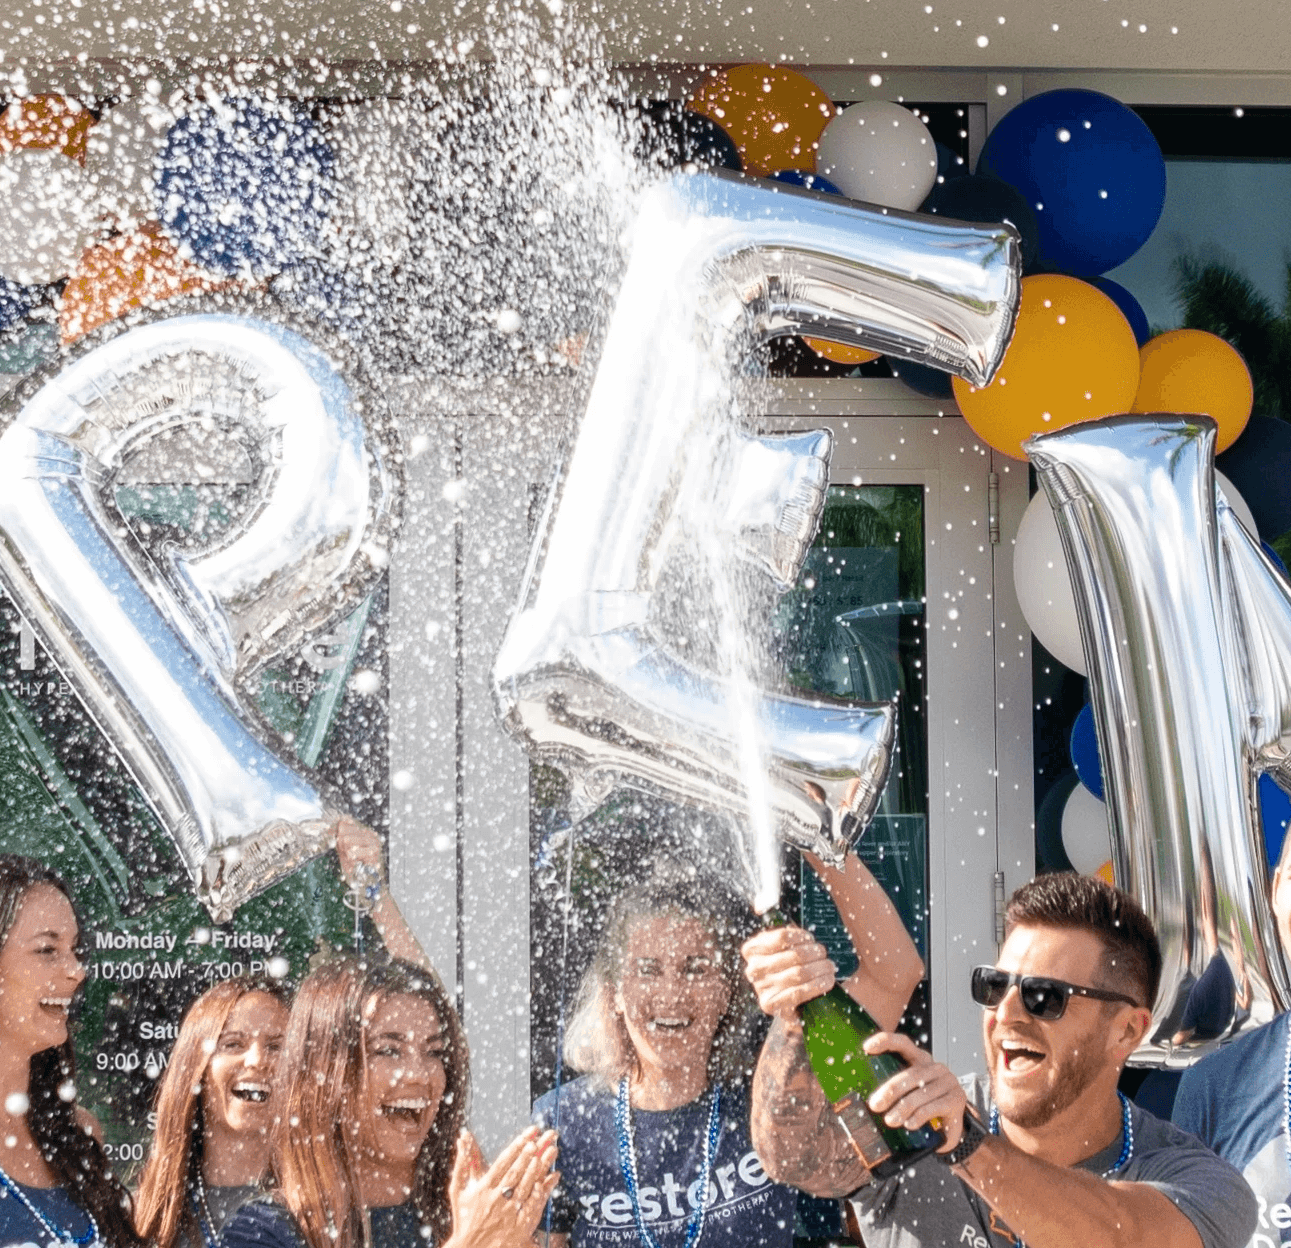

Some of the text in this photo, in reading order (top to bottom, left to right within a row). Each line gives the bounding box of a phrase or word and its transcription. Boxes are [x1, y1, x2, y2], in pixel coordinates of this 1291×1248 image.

[19, 682, 69, 696] HYPE
[95, 931, 177, 953] Monday
[211, 930, 276, 953] Friday
[91, 962, 144, 980] 10:00
[149, 961, 182, 979] AM
[201, 961, 243, 979] 7:00
[96, 1053, 140, 1071] 9:00
[102, 1143, 144, 1161] 2:00
[579, 1151, 772, 1224] restore
[707, 1189, 776, 1224] RYOTHERAPY
